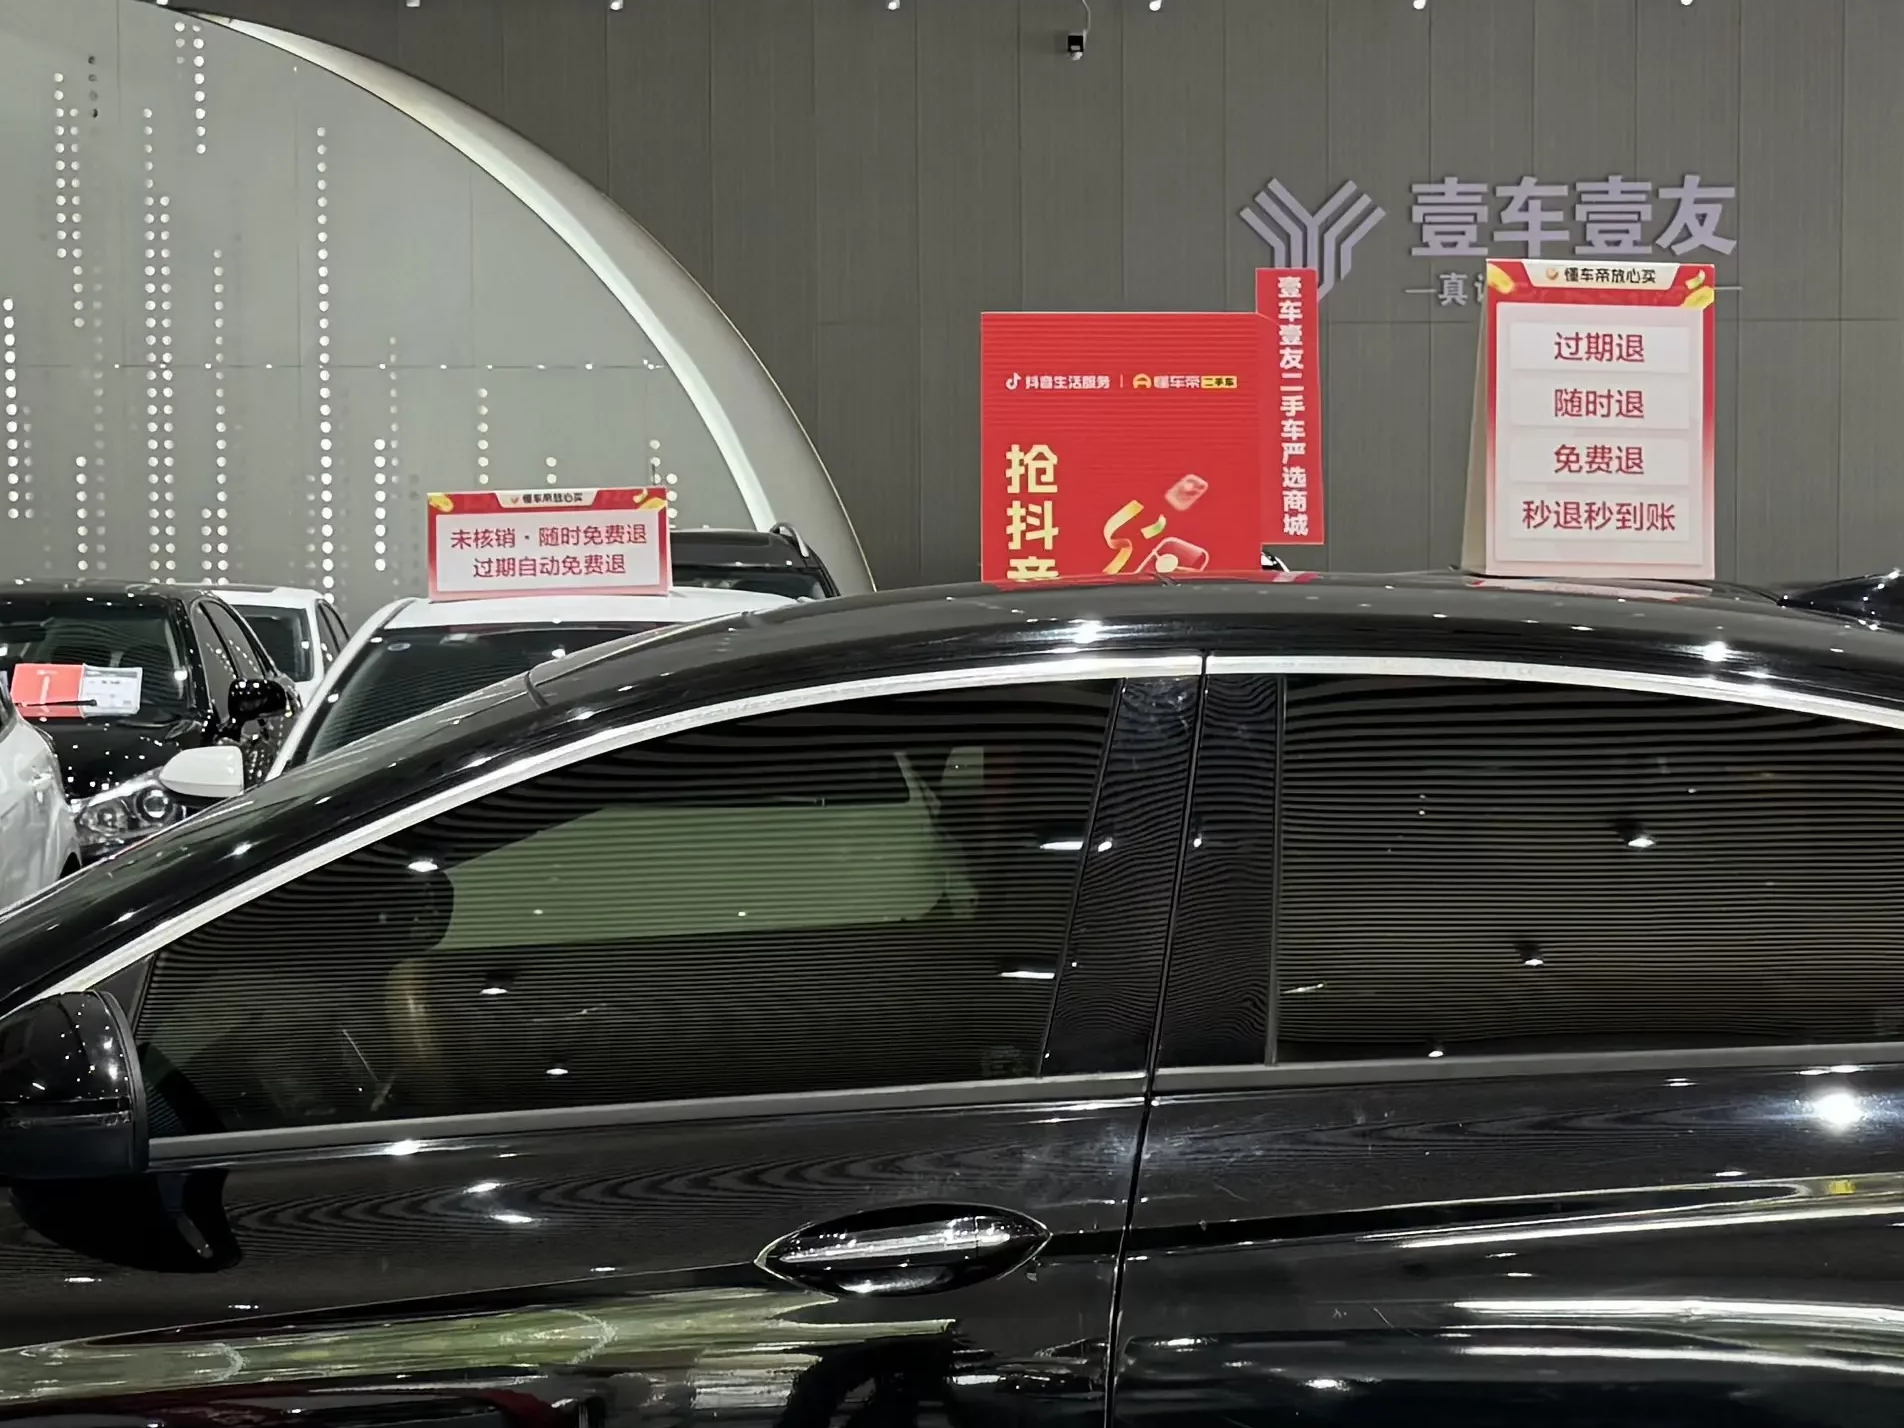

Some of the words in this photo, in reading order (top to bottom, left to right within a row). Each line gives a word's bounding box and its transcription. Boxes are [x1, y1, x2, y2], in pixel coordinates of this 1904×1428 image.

[1410, 173, 1738, 258] 壹车壹友
[1563, 266, 1657, 285] 懂车帝放心买
[1552, 330, 1646, 364] 过期退
[1025, 374, 1111, 390] 抖音生活服务
[1153, 374, 1201, 390] 懂车帝
[1277, 274, 1310, 537] 壹车壹友二手车严选商城
[1552, 387, 1646, 420] 随时退
[1552, 443, 1646, 476] 免费退
[1521, 499, 1678, 534] 秒退秒到账
[472, 553, 627, 580] 过期自动免费退
